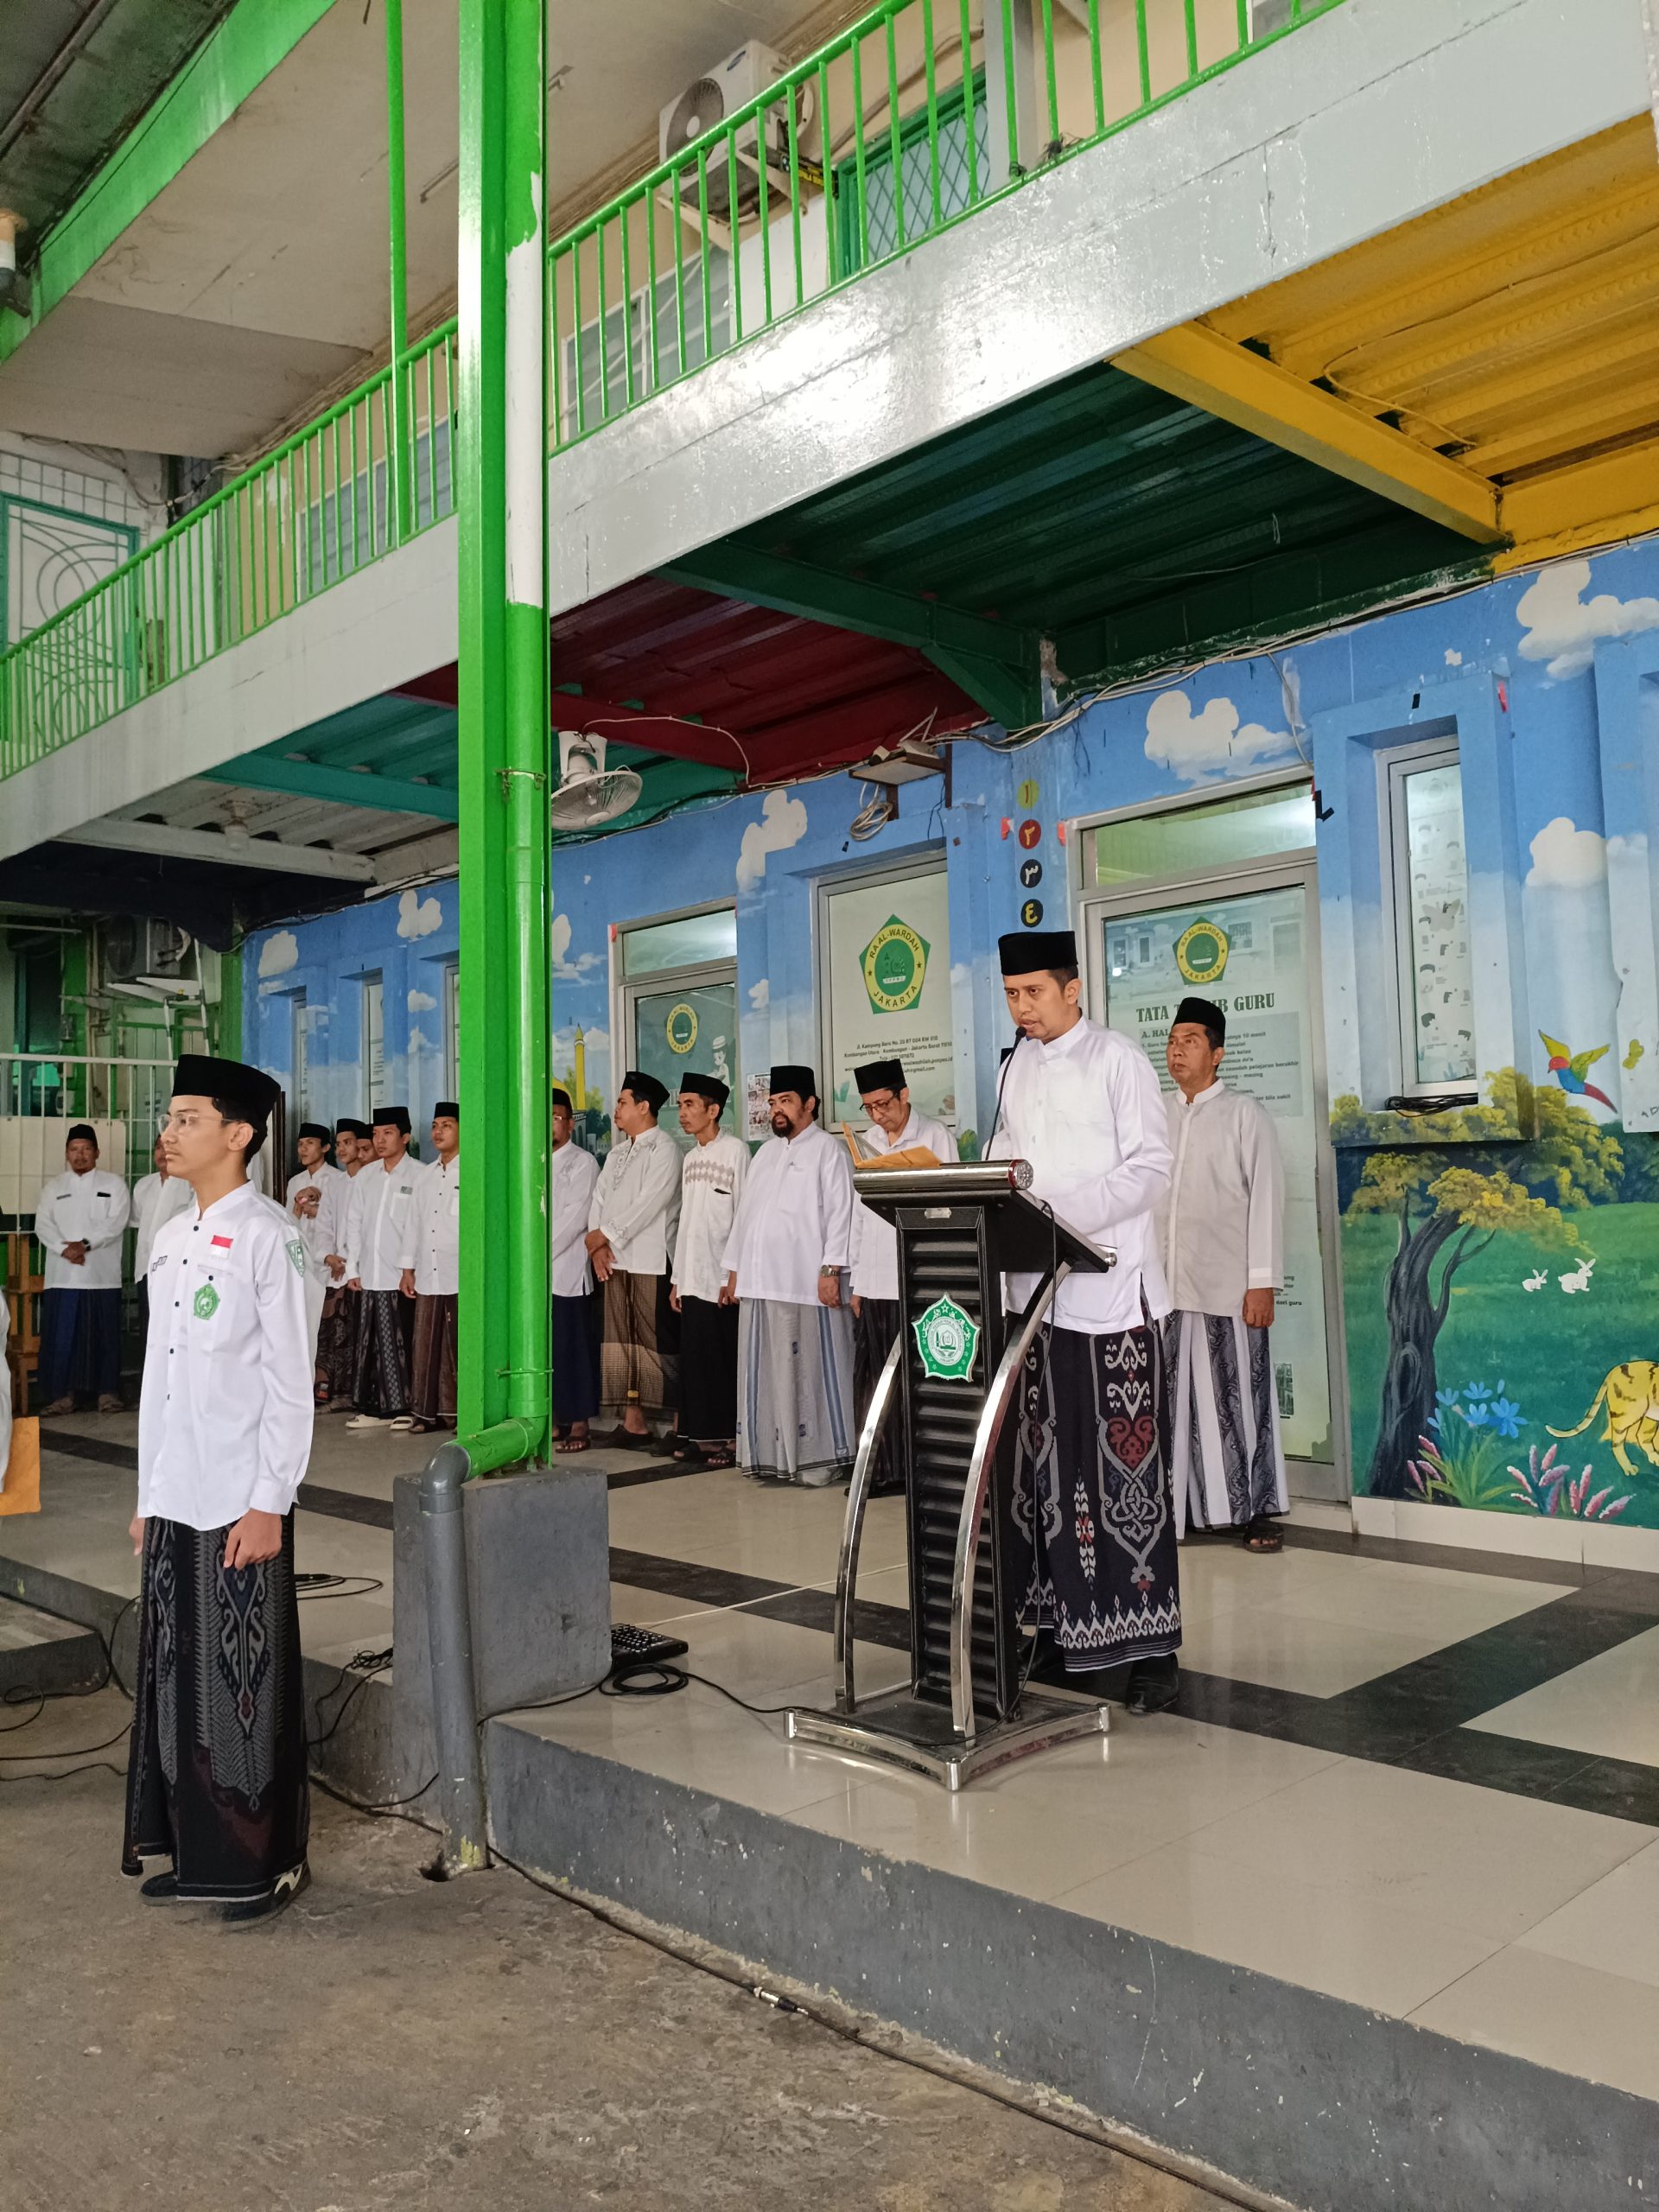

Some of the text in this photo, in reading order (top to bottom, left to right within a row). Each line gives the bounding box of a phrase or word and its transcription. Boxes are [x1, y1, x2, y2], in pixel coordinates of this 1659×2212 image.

[1024, 825, 1036, 846] ٢
[1025, 865, 1039, 885] ٣
[1025, 903, 1039, 924] ٤
[869, 928, 920, 959] RA AL-WARDAH
[874, 985, 918, 1007] JAKARTA
[1136, 1005, 1169, 1022] TATA
[1234, 993, 1274, 1012] GURU
